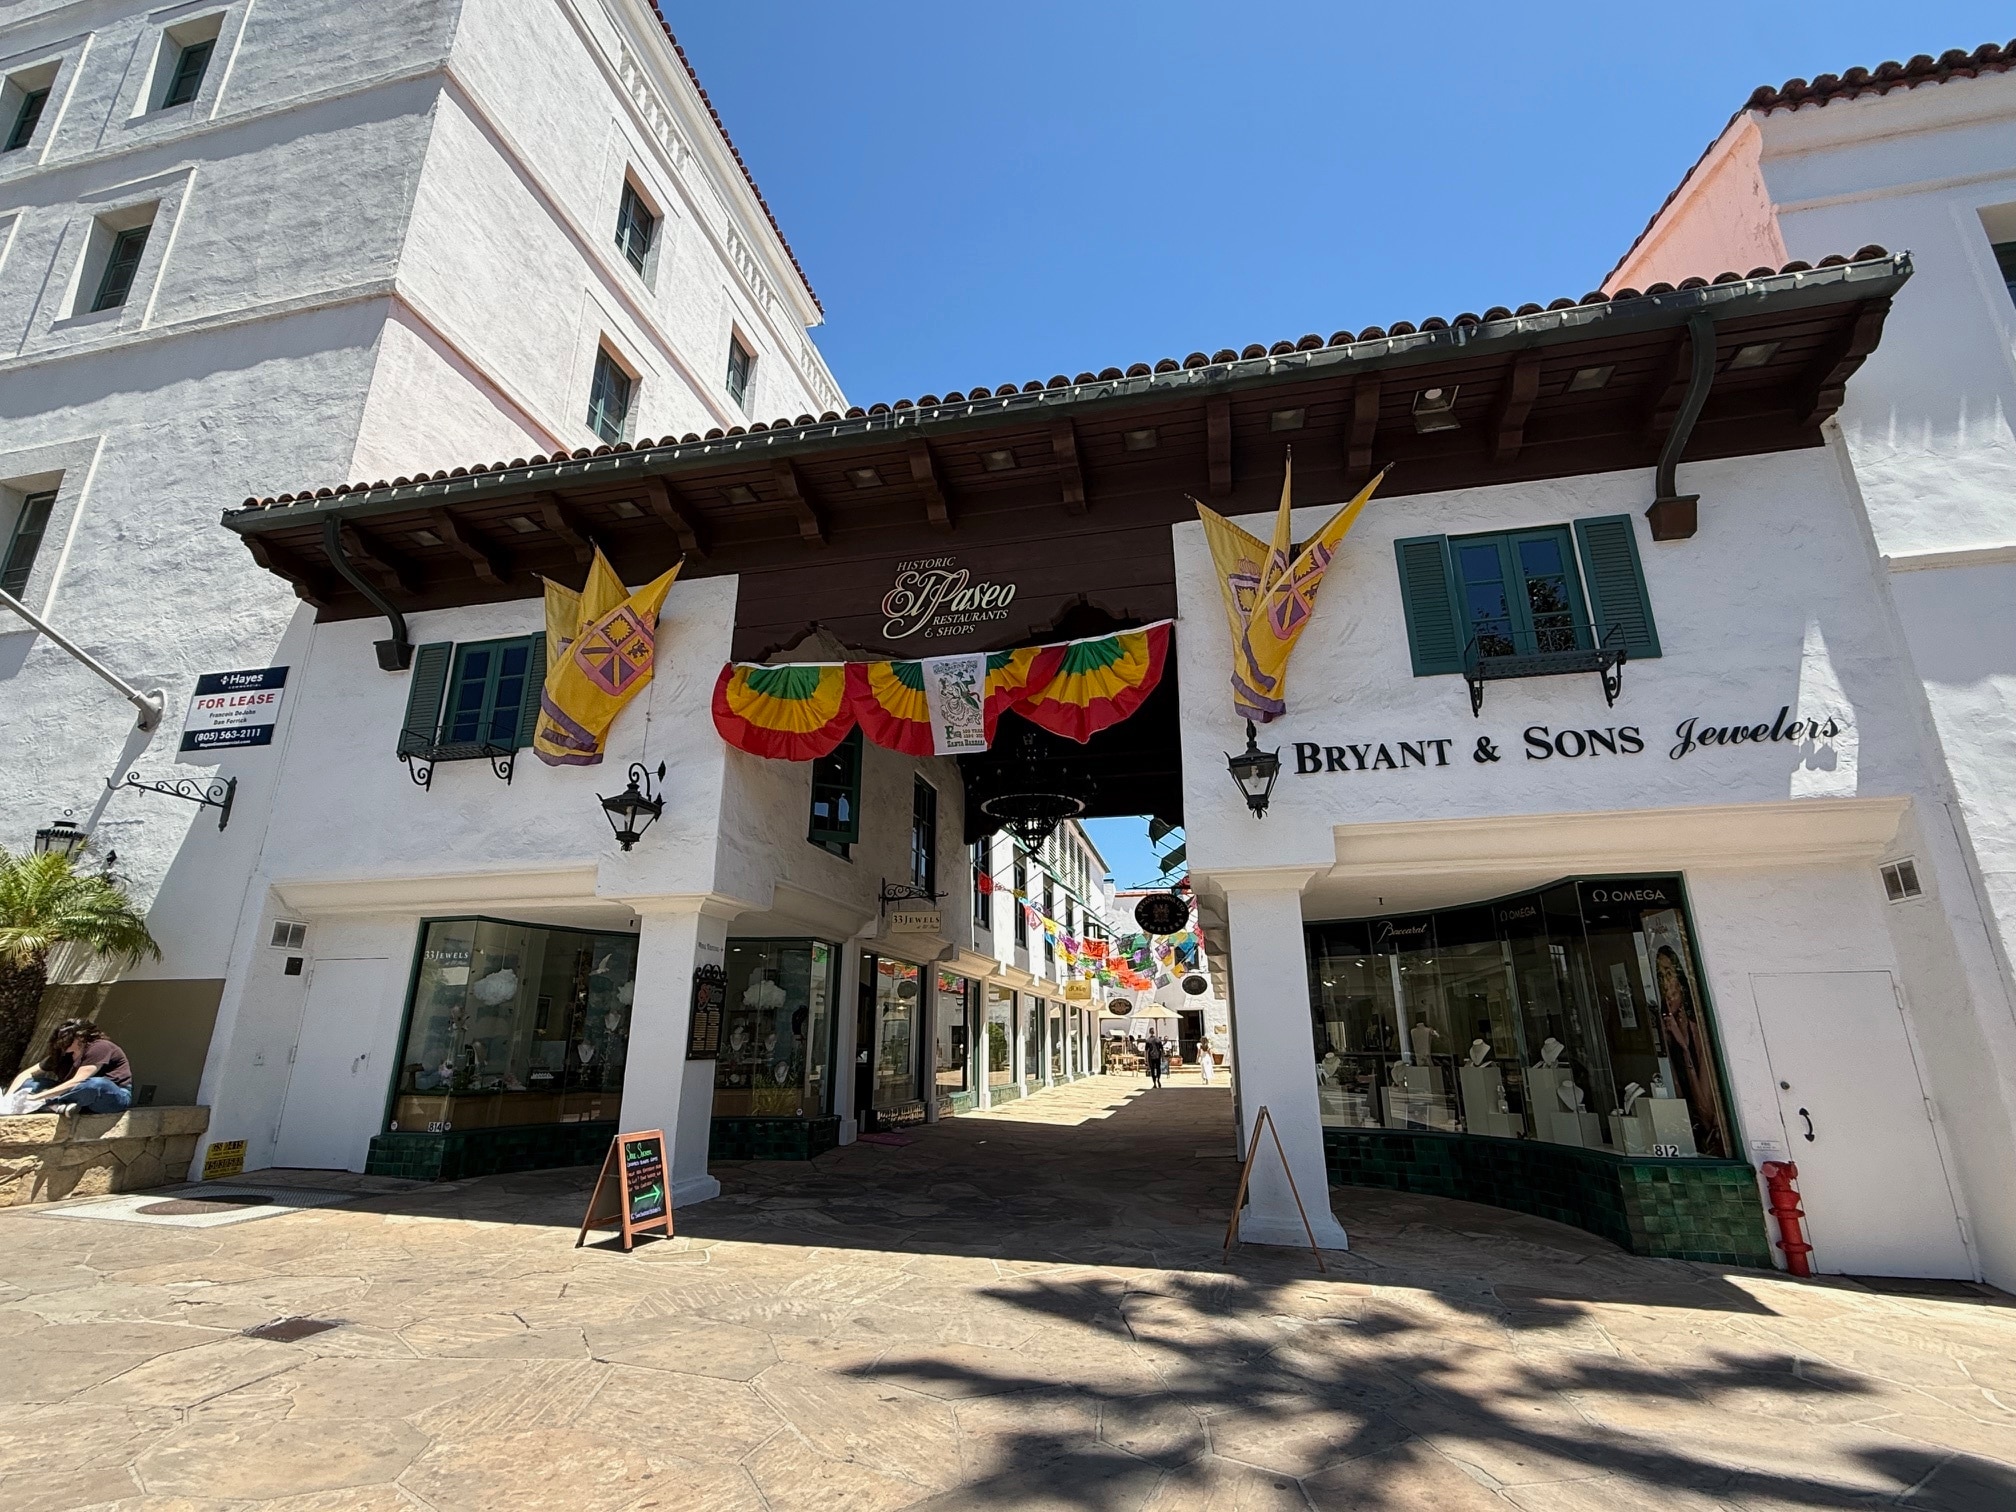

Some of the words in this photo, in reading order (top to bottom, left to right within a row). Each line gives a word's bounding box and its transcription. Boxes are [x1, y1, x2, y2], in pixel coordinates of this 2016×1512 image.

[896, 556, 956, 571] HISTORIC
[881, 570, 937, 618] El
[932, 609, 1009, 626] RESTAURANTS
[924, 627, 934, 638] &
[936, 624, 976, 637] SHOPS
[229, 674, 264, 685] Hayes
[197, 697, 225, 710] FOR
[229, 693, 275, 707] LEASE
[194, 732, 219, 743] (805)
[219, 728, 262, 739] 563-2111
[1291, 738, 1453, 775] BRYANT
[1473, 736, 1501, 763] &
[1523, 726, 1645, 760] SONS
[1669, 705, 1841, 760] Jewelers
[1612, 889, 1666, 902] OMEGA
[1508, 905, 1536, 920] OMEGA
[1376, 920, 1428, 944] Baccarat
[428, 1122, 442, 1132] 814
[1654, 1145, 1679, 1157] 812
